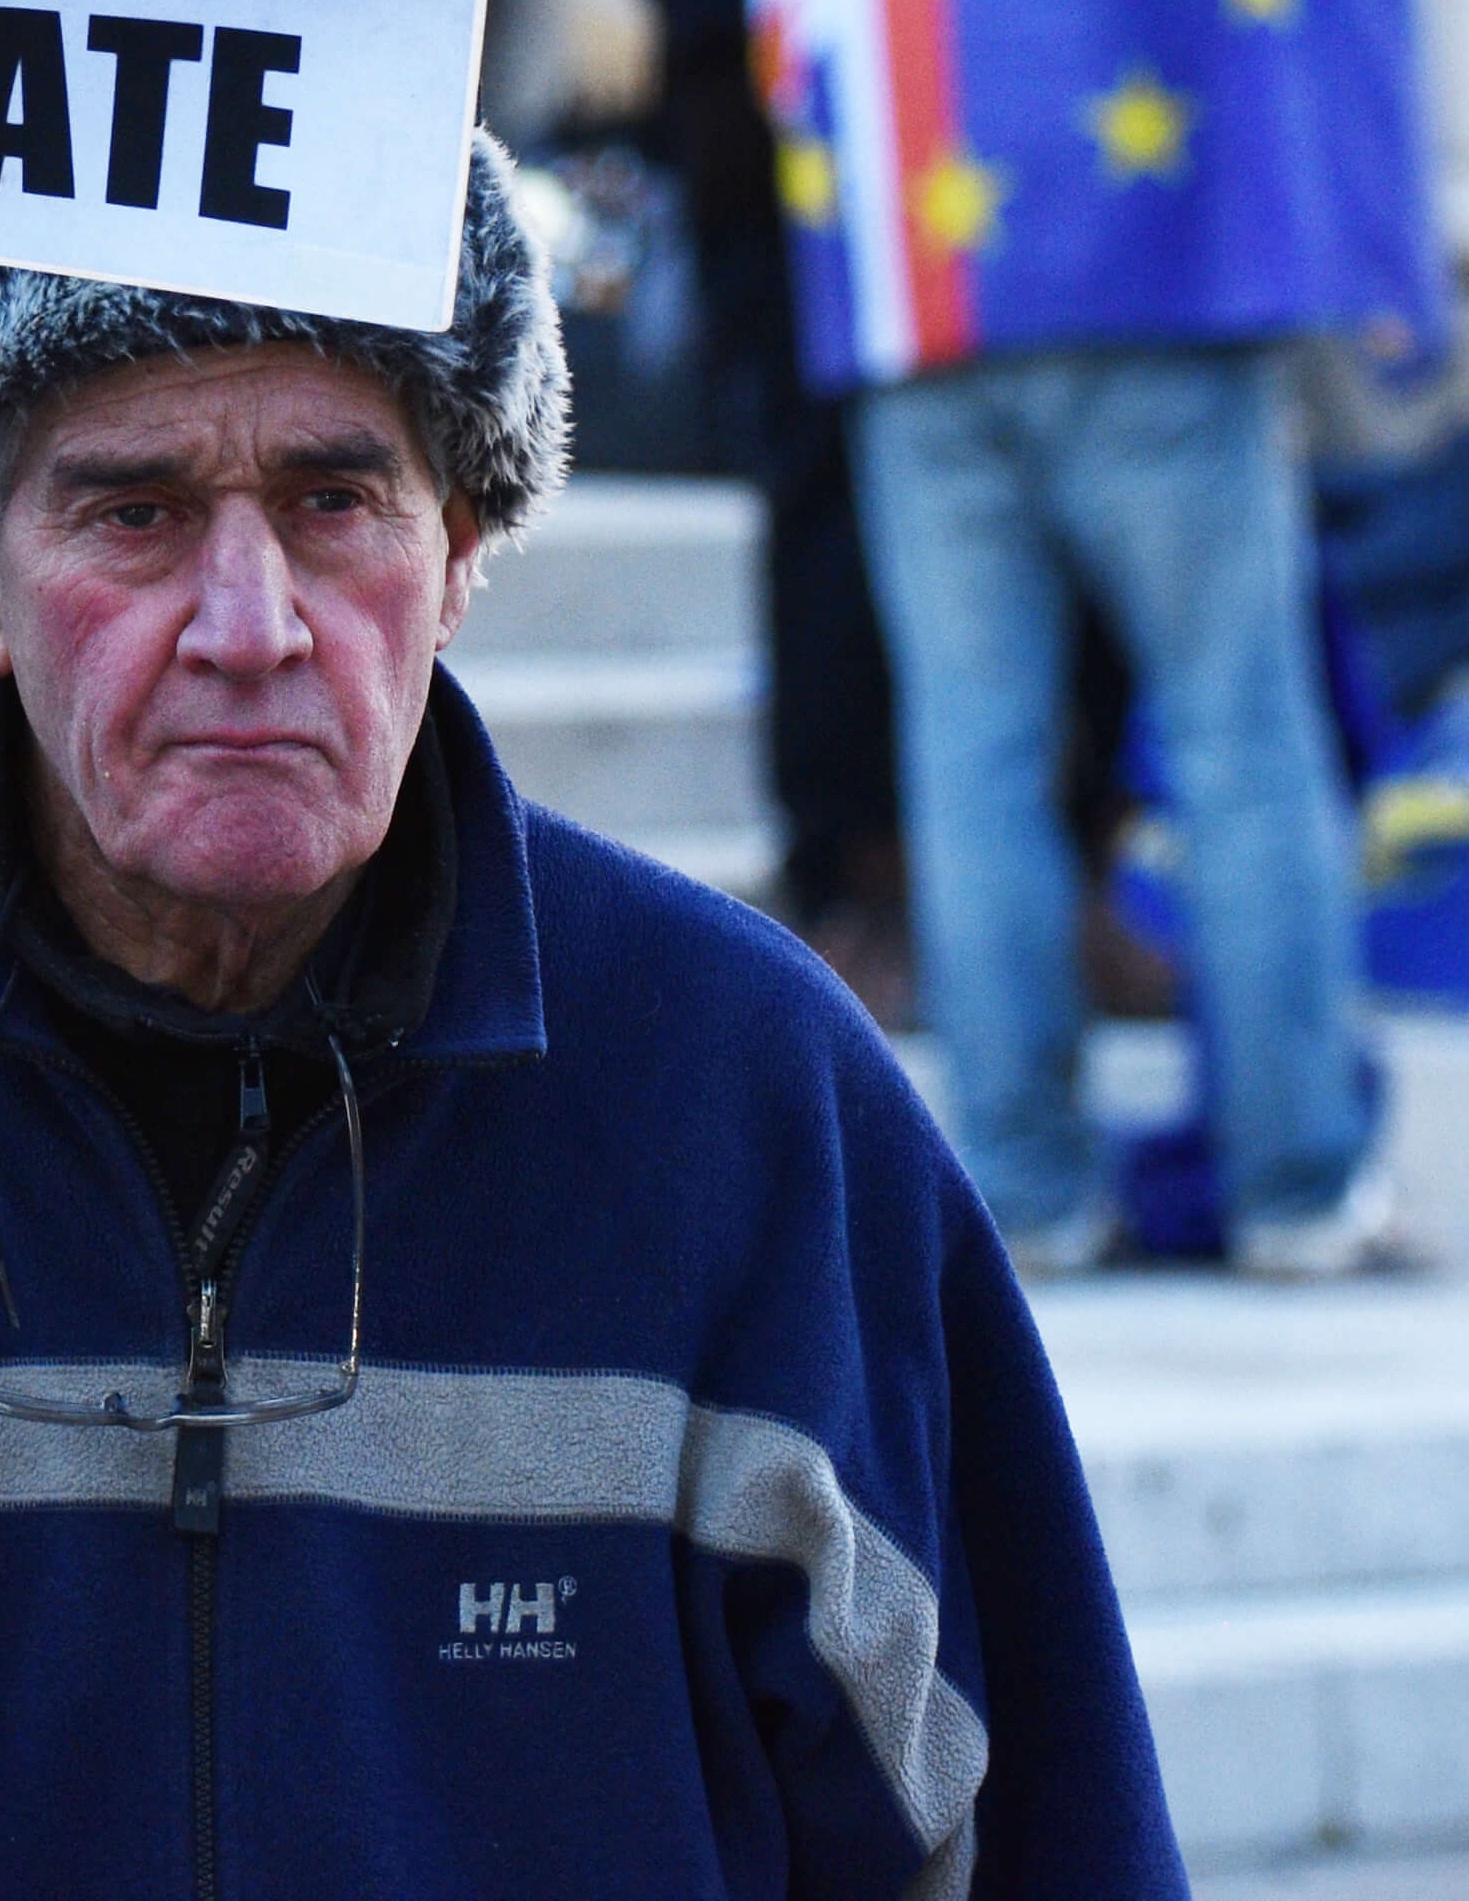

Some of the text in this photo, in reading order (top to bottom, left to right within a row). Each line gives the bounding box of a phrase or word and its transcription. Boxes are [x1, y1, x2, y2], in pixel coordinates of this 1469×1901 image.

[194, 1145, 258, 1251] Result
[439, 1641, 578, 1660] HELLY HANSEN
